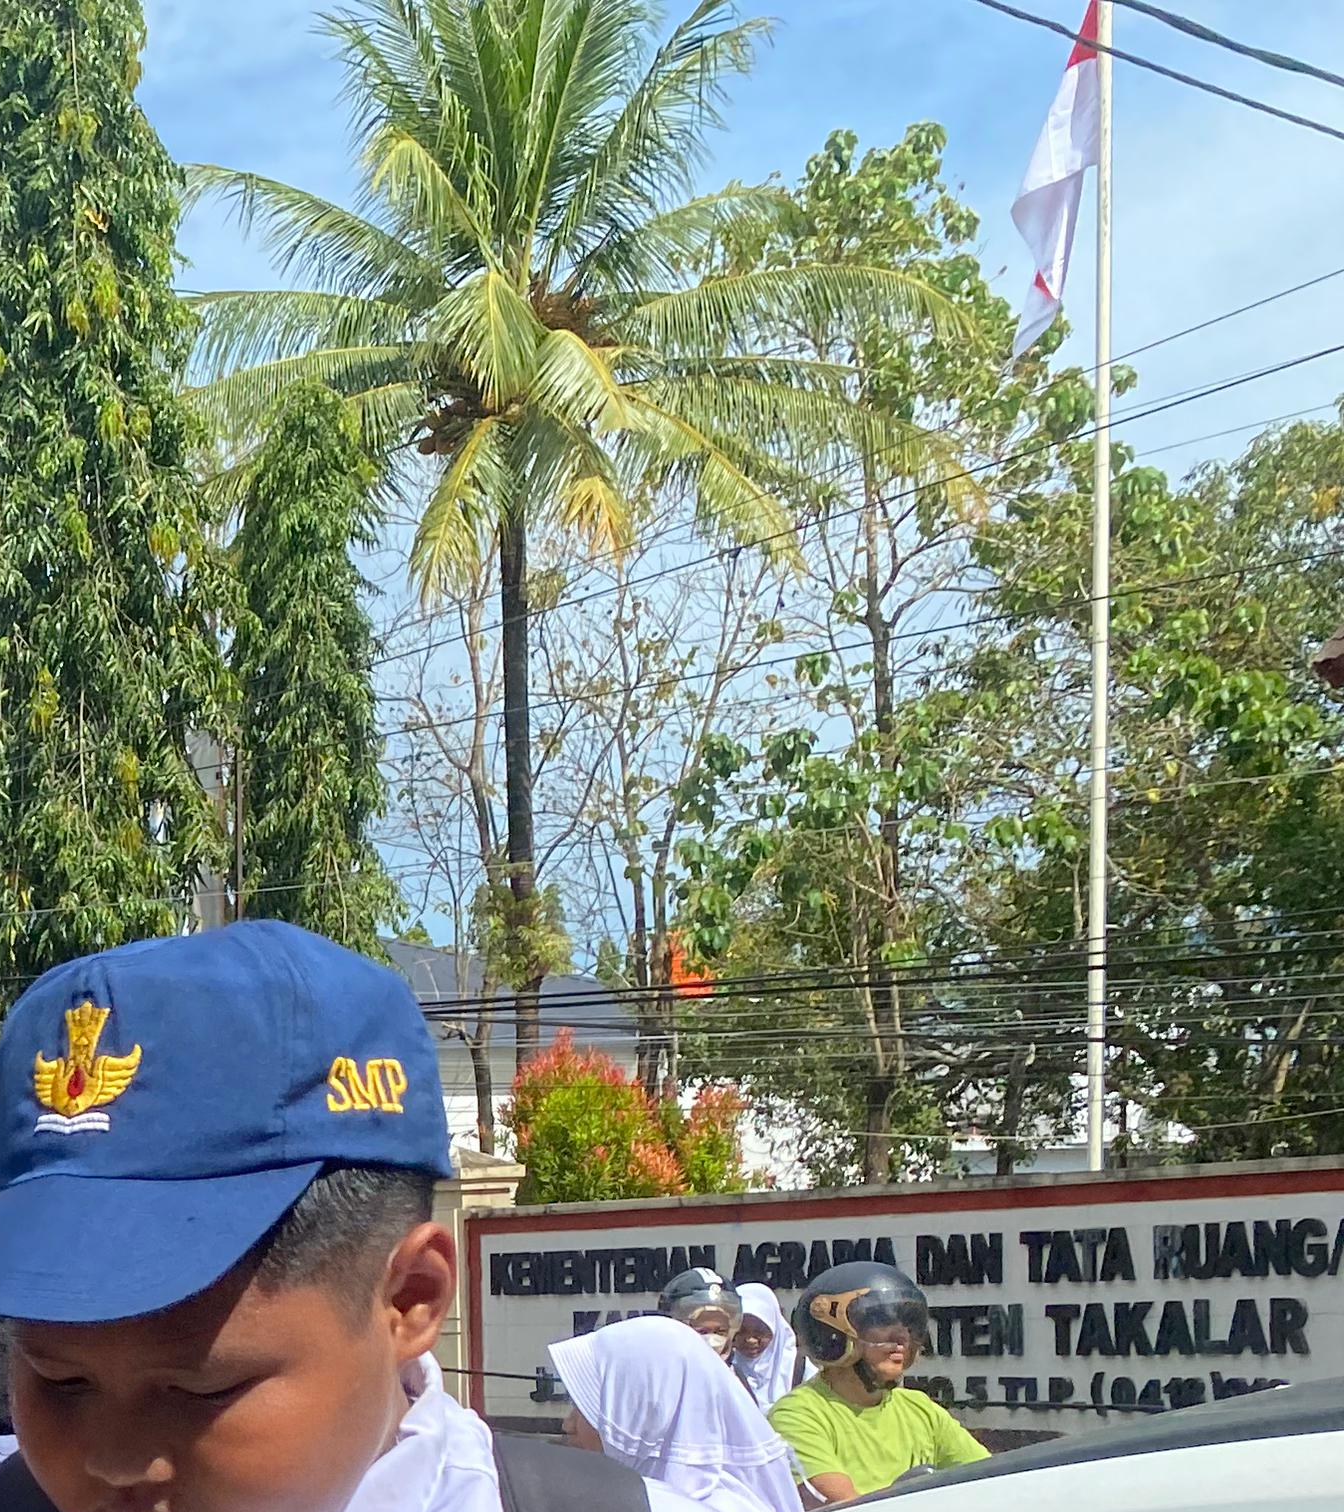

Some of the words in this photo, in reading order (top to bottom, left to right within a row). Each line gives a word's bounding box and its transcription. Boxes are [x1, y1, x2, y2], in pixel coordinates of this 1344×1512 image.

[326, 1056, 408, 1113] SMP
[489, 1244, 716, 1296] KEMENTERIAN
[916, 1232, 1003, 1285] DAN
[1020, 1227, 1136, 1283] TATA
[1045, 1298, 1311, 1357] TAKALAR
